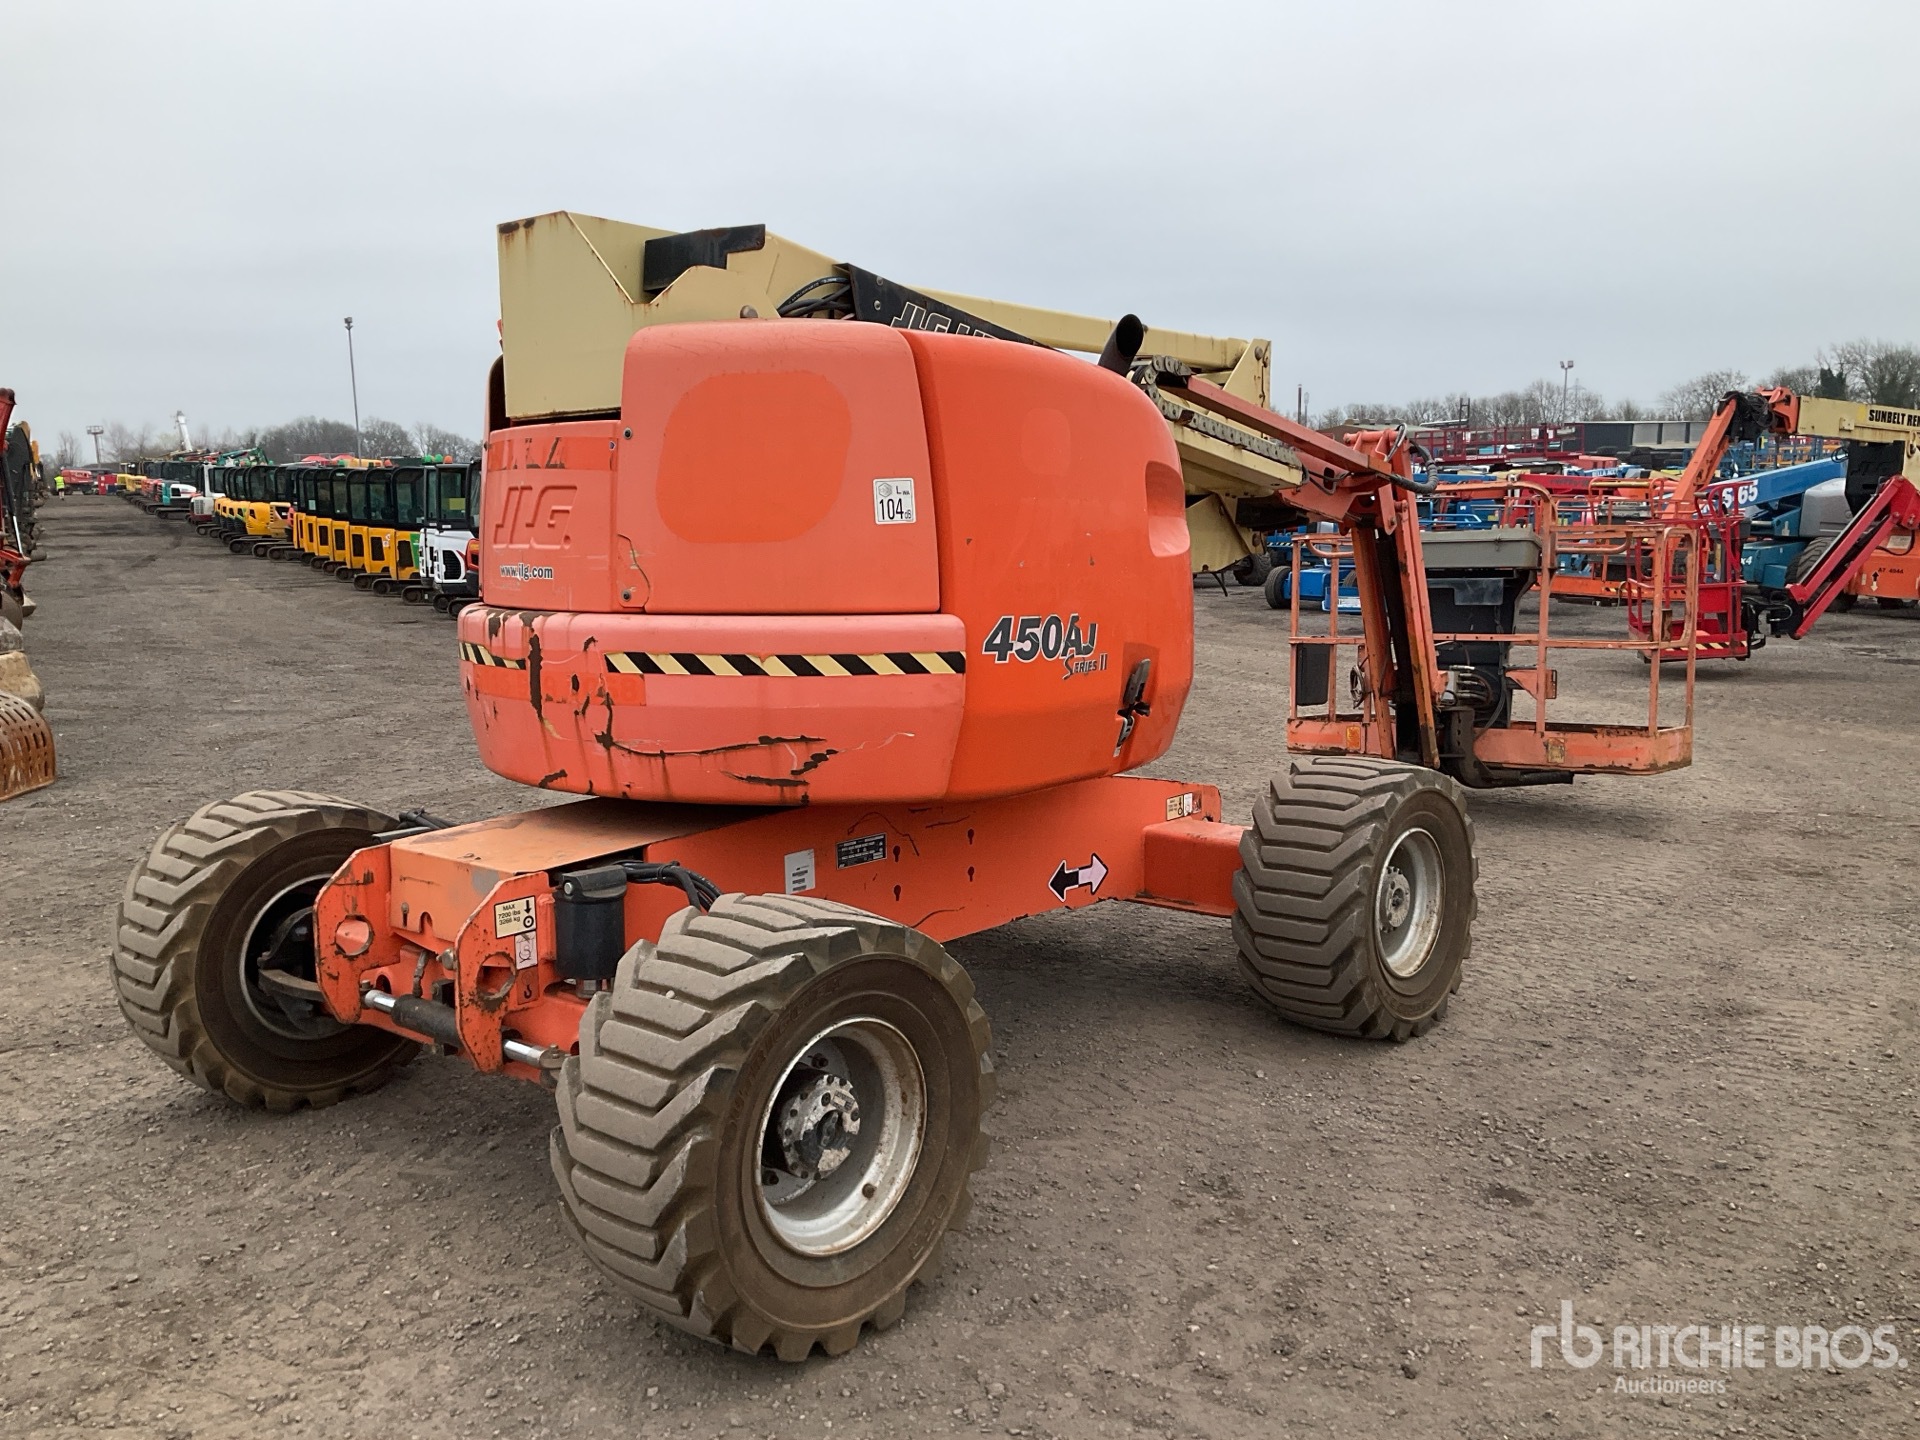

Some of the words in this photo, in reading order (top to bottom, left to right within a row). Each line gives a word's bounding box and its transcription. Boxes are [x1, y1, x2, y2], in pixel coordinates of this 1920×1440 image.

[1868, 409, 1906, 425] SUNBELT
[879, 498, 904, 520] 104
[500, 562, 553, 581] www.jlg.com
[982, 613, 1098, 663] 450AJ
